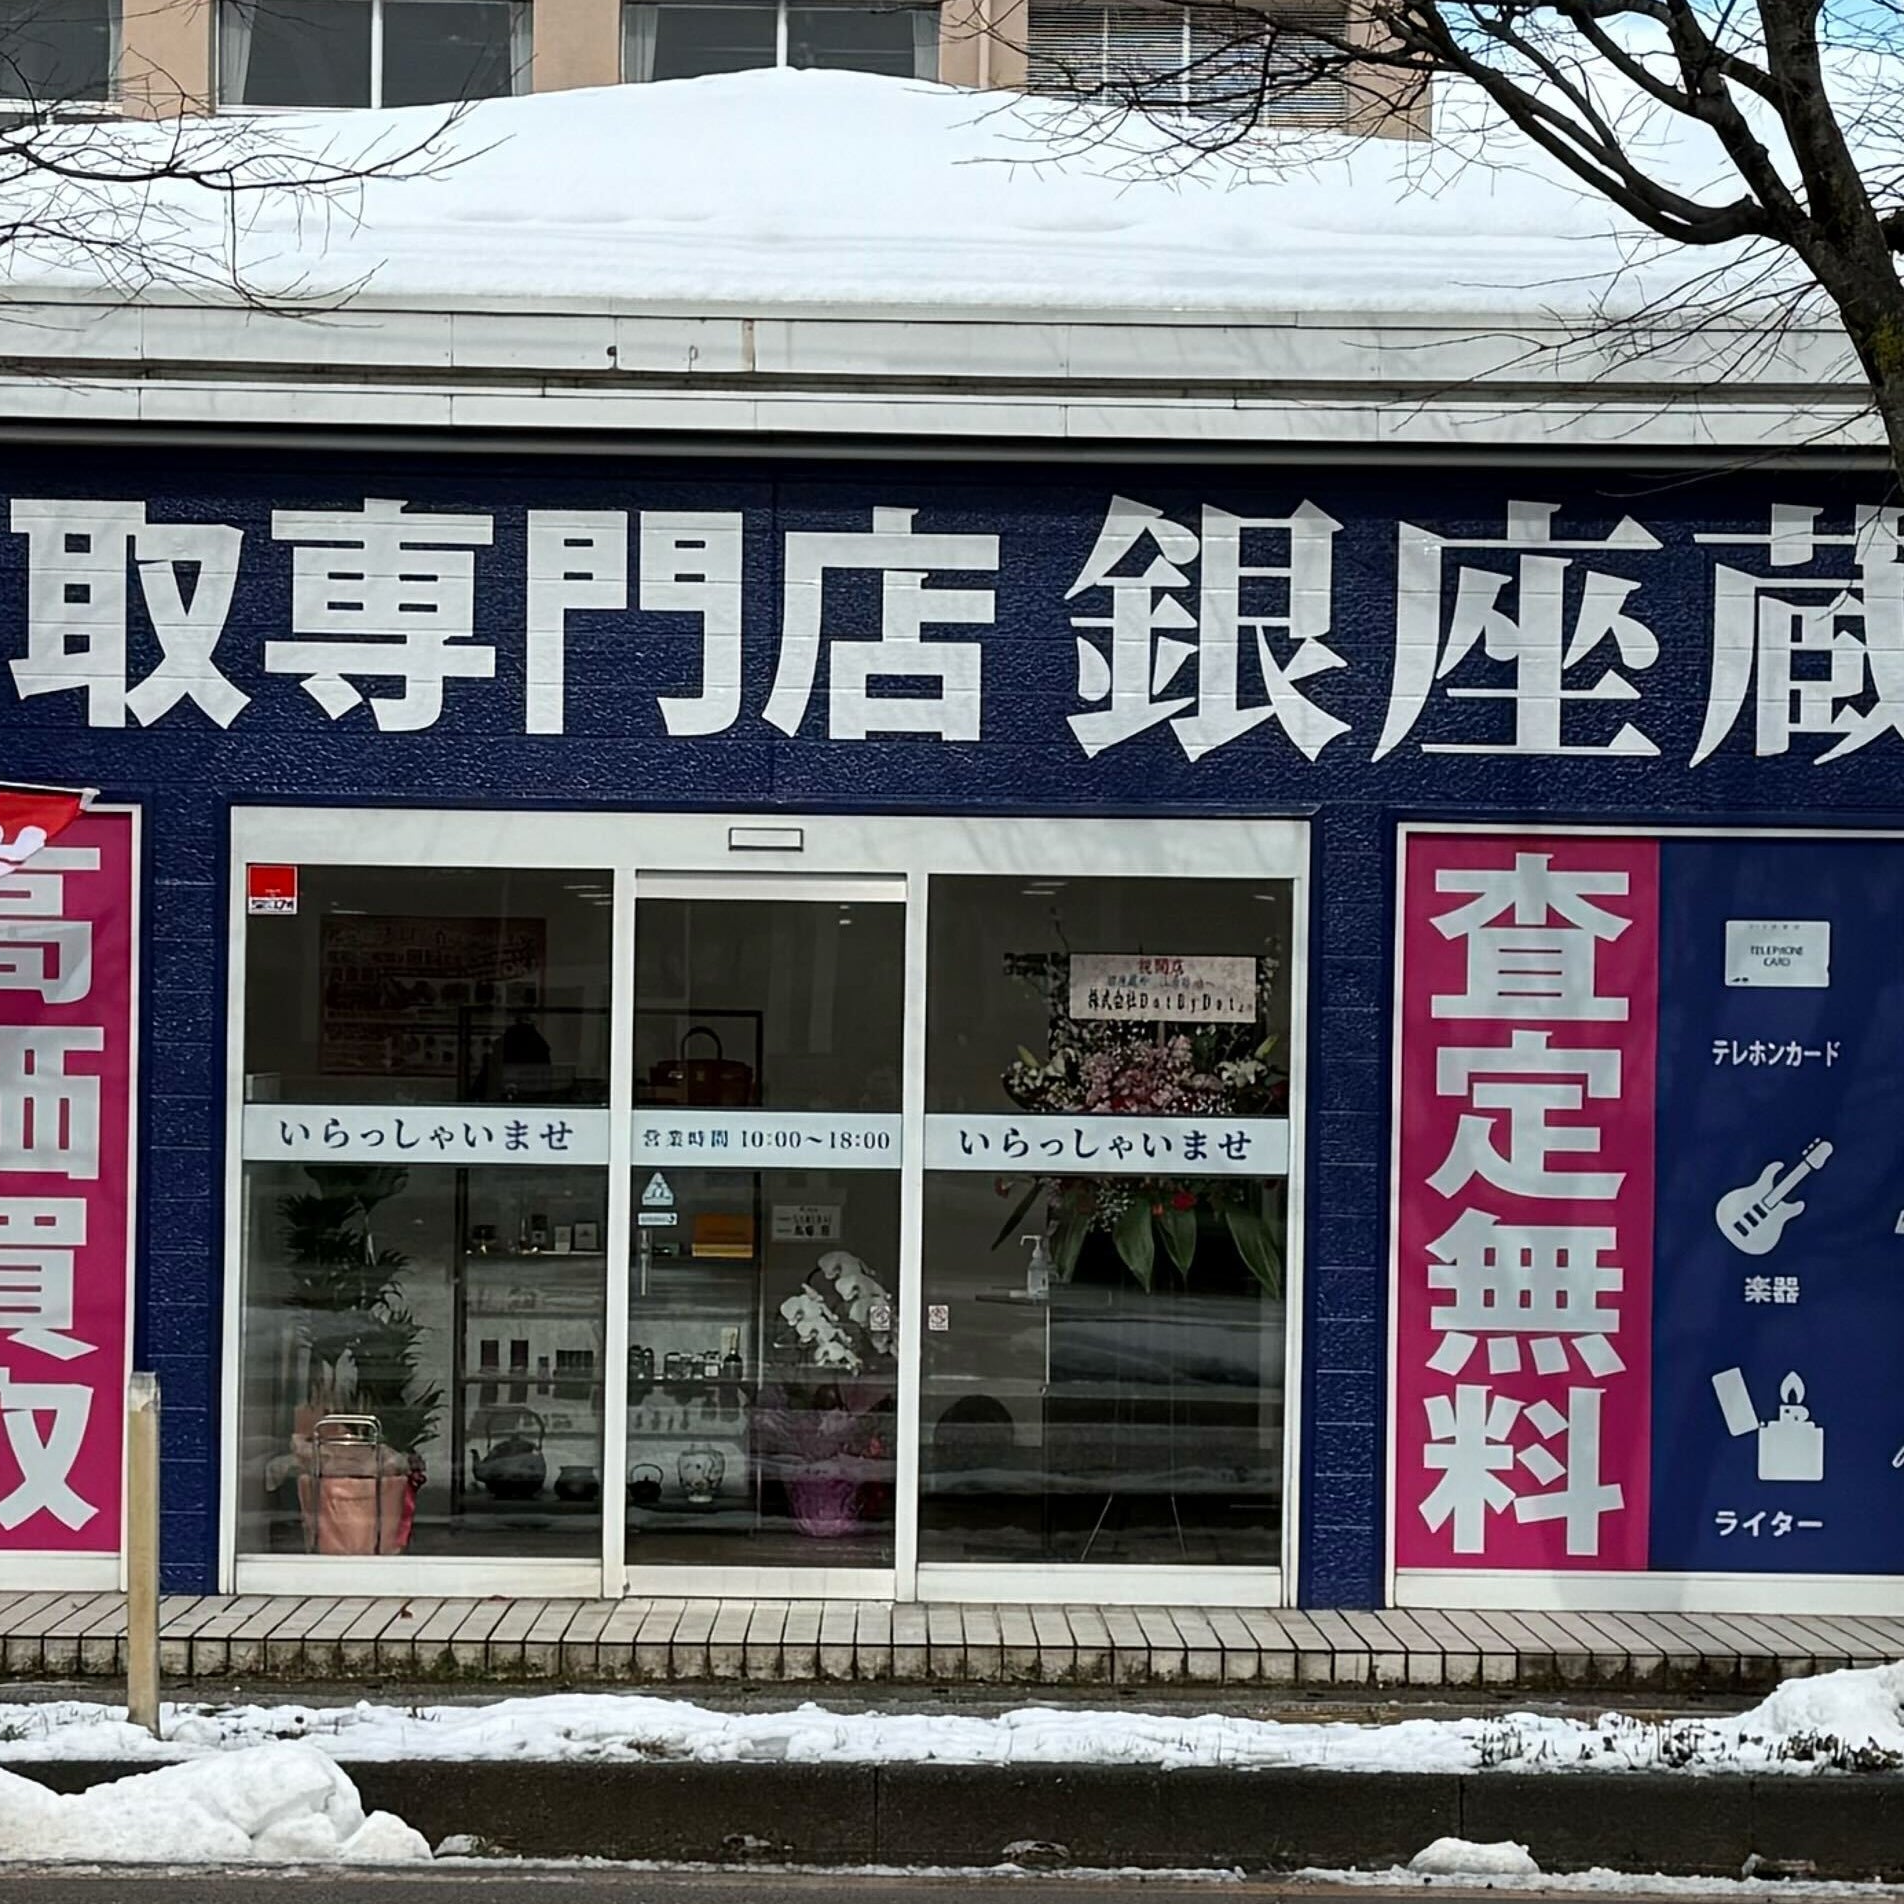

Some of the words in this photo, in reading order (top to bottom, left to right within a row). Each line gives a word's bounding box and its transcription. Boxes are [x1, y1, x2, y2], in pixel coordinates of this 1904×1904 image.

[1712, 1040, 1841, 1067] テレホンカード
[280, 1118, 574, 1150] いらっしゃいませ
[643, 1129, 729, 1148] 営業時間
[959, 1127, 1252, 1160] いらっしゃいませ
[1417, 851, 1633, 1556] 査定無料
[1744, 1275, 1800, 1304] 楽器
[1714, 1510, 1824, 1537] ライター
